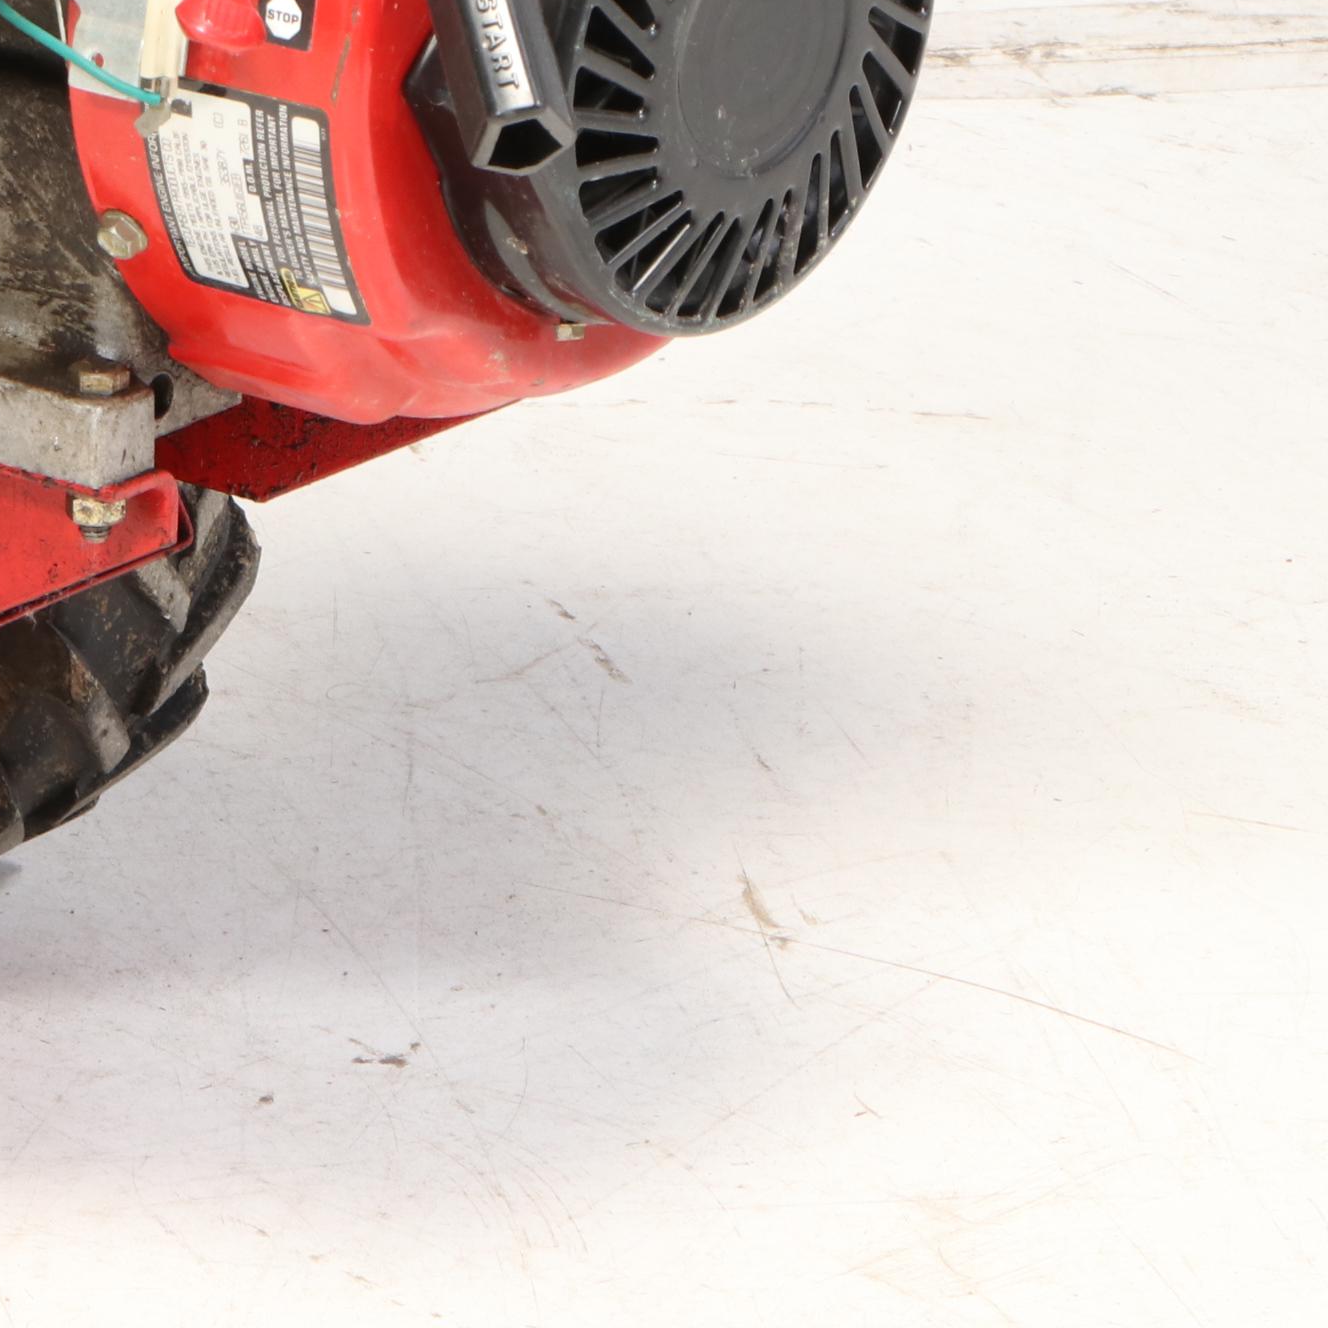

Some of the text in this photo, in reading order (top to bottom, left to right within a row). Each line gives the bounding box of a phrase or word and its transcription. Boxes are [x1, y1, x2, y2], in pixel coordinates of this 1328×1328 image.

[266, 8, 300, 25] STOP
[267, 114, 279, 169] IMPORTANT
[278, 104, 290, 169] INFORMATION
[153, 172, 171, 212] ENGINE
[255, 109, 286, 262] FOR PERSONAL PROTECTION REFER
[272, 171, 281, 189] FOR
[275, 193, 289, 228] MANUAL
[283, 171, 301, 234] MAINTENANCE
[295, 235, 306, 254] AND
